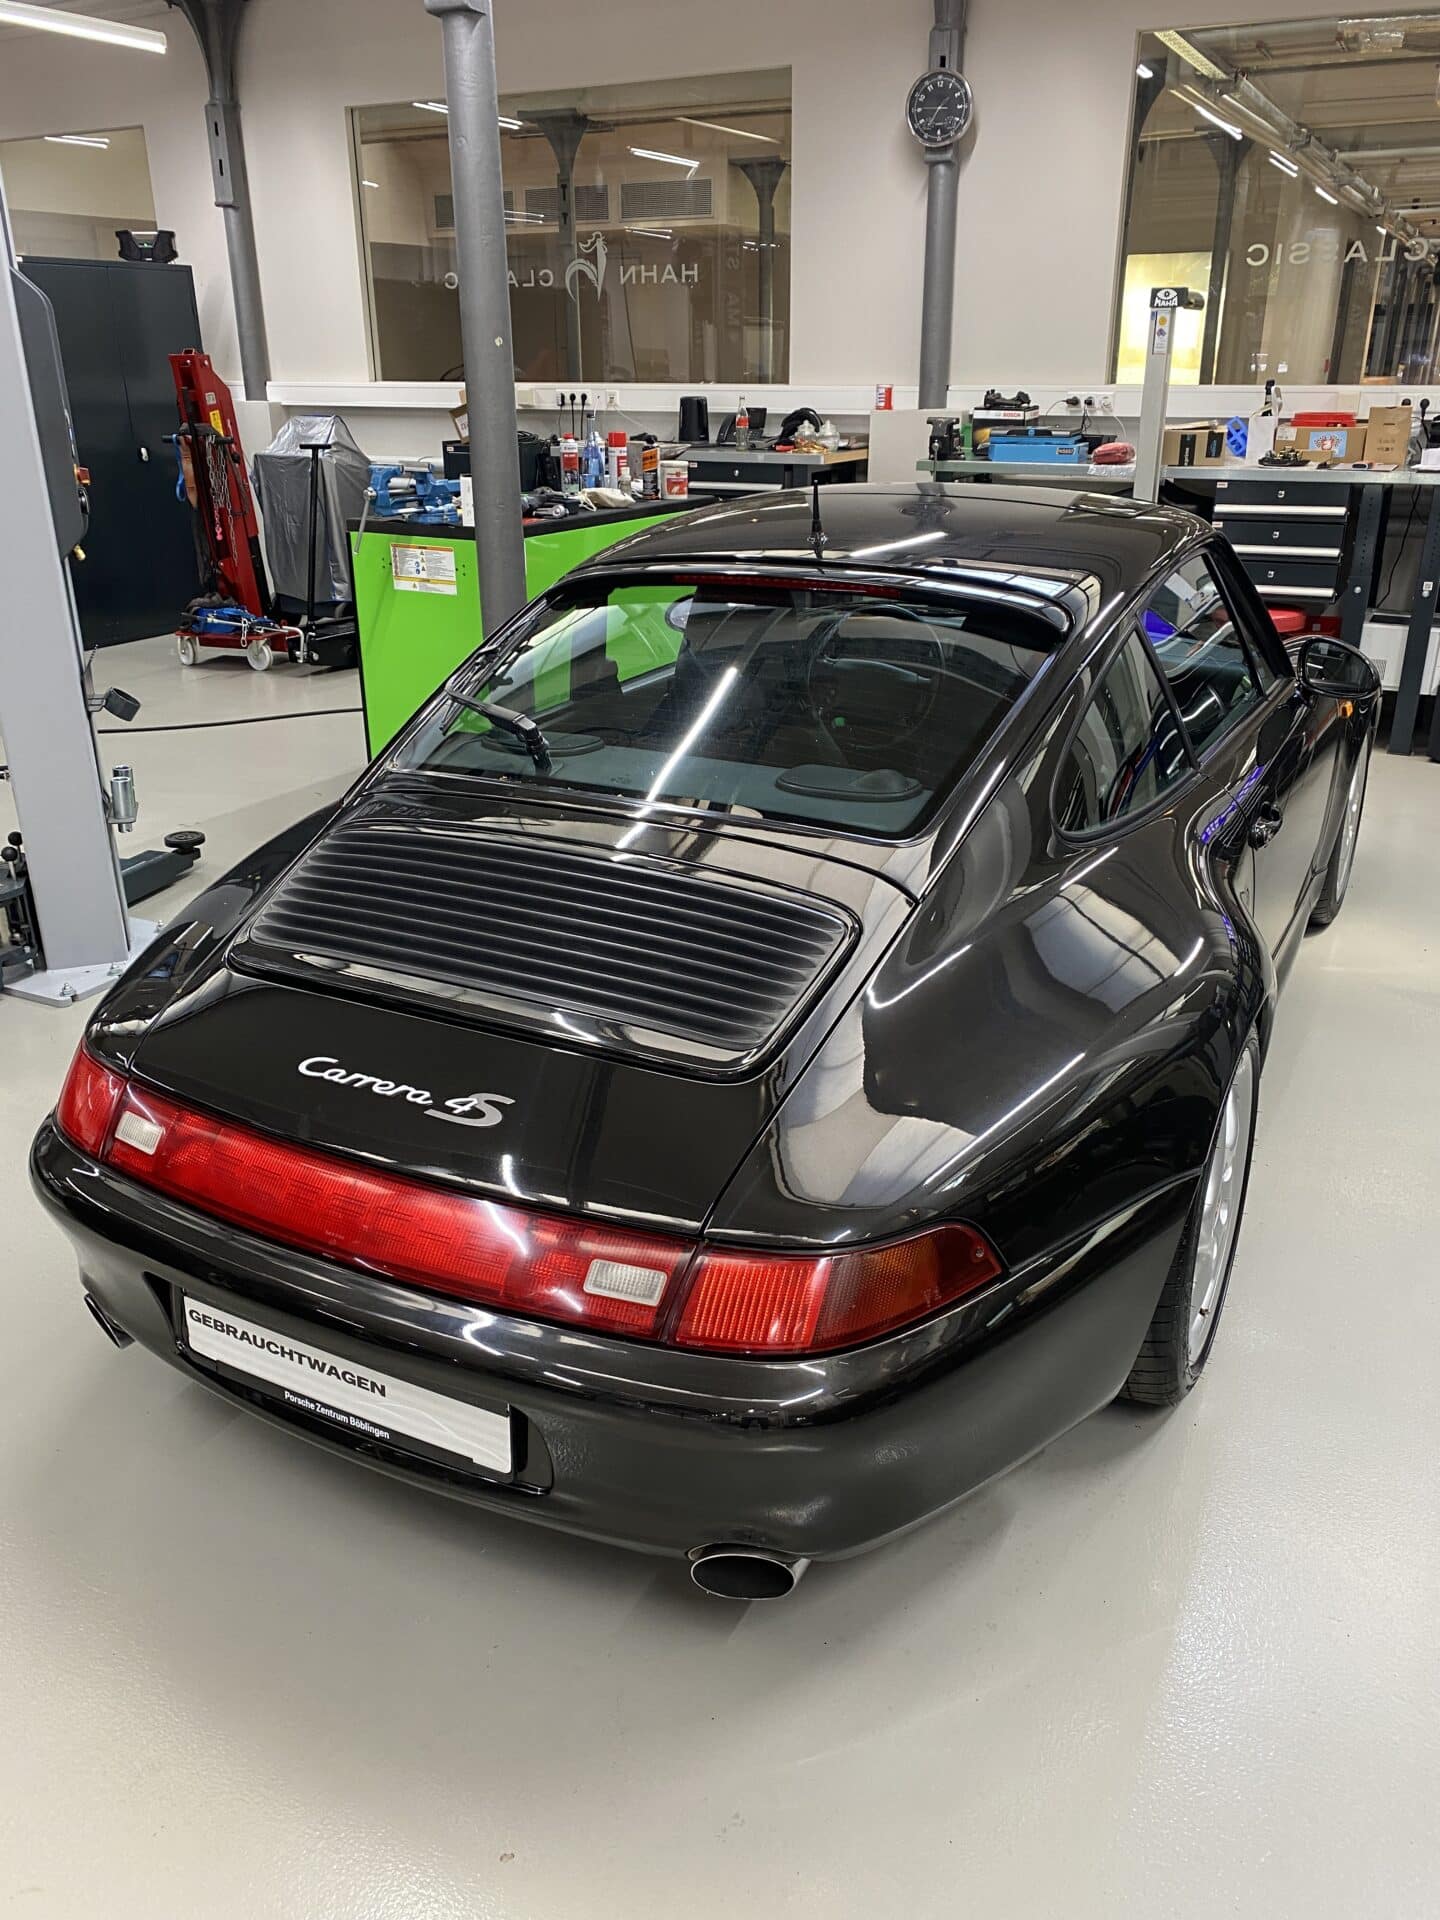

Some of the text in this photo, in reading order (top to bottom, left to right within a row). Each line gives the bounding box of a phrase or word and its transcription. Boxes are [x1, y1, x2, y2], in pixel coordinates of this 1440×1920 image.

[1154, 296, 1178, 307] MAHA
[298, 1056, 433, 1105] Carrera
[188, 1308, 387, 1398] GEBRAUCHTWAGEN
[284, 1390, 390, 1440] Porsche Zentrum Böblingen
